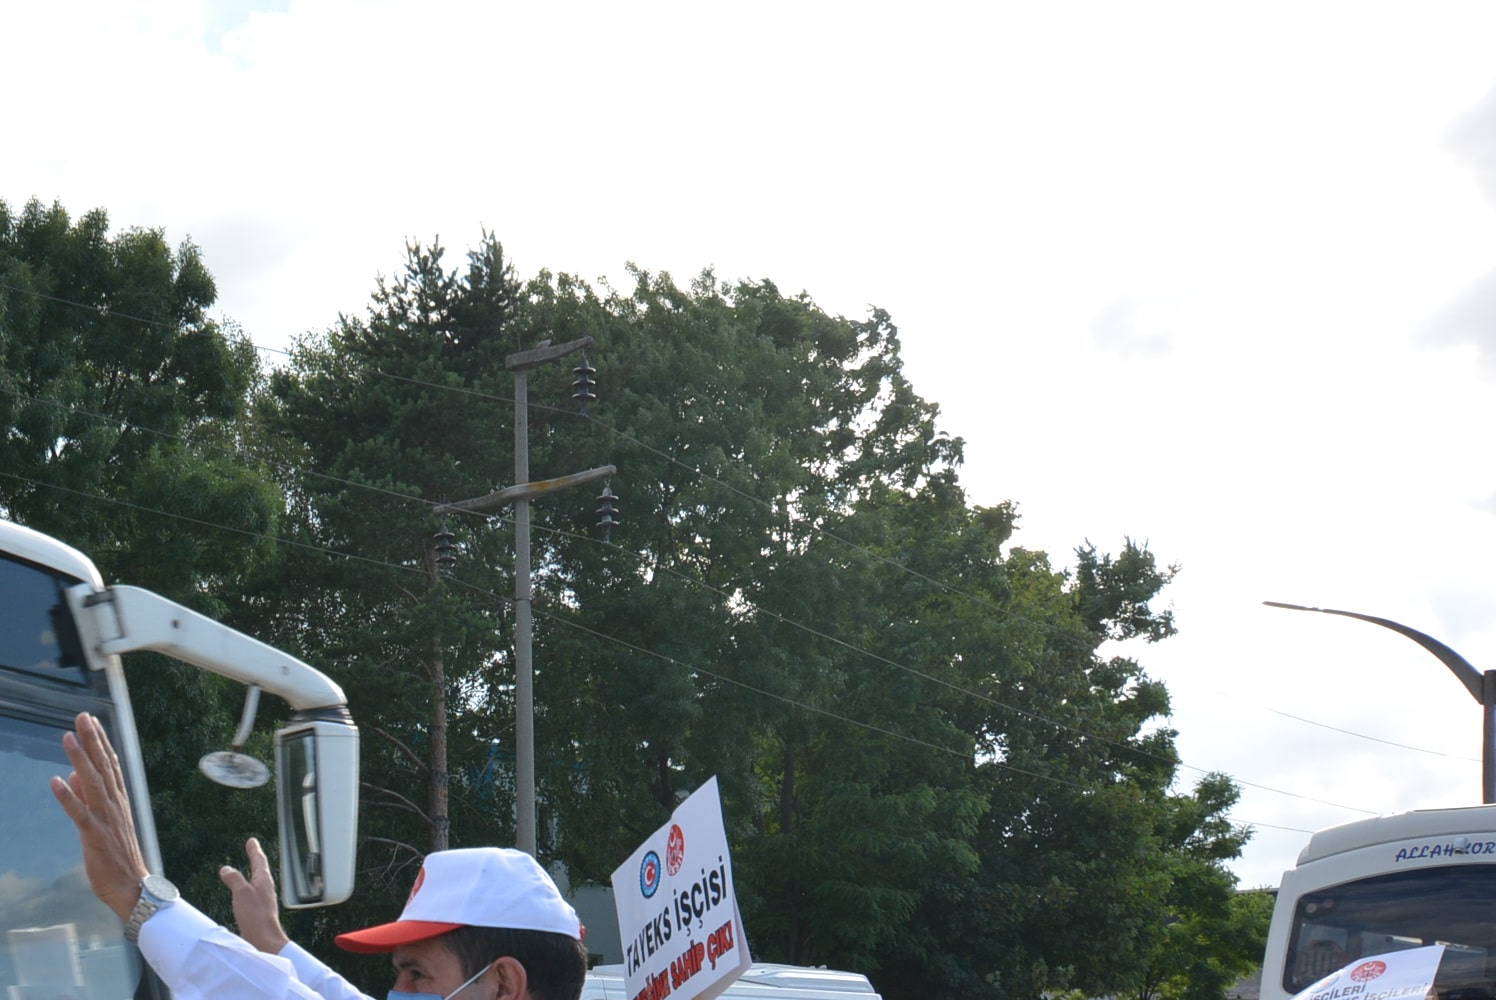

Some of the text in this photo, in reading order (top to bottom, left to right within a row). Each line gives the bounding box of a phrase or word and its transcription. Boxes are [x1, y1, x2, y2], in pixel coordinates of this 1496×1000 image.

[1395, 843, 1454, 863] ALLAH
[626, 906, 672, 978] TAYEKS
[673, 855, 727, 937] İŞÇİSİ
[670, 939, 705, 990] SAHİP
